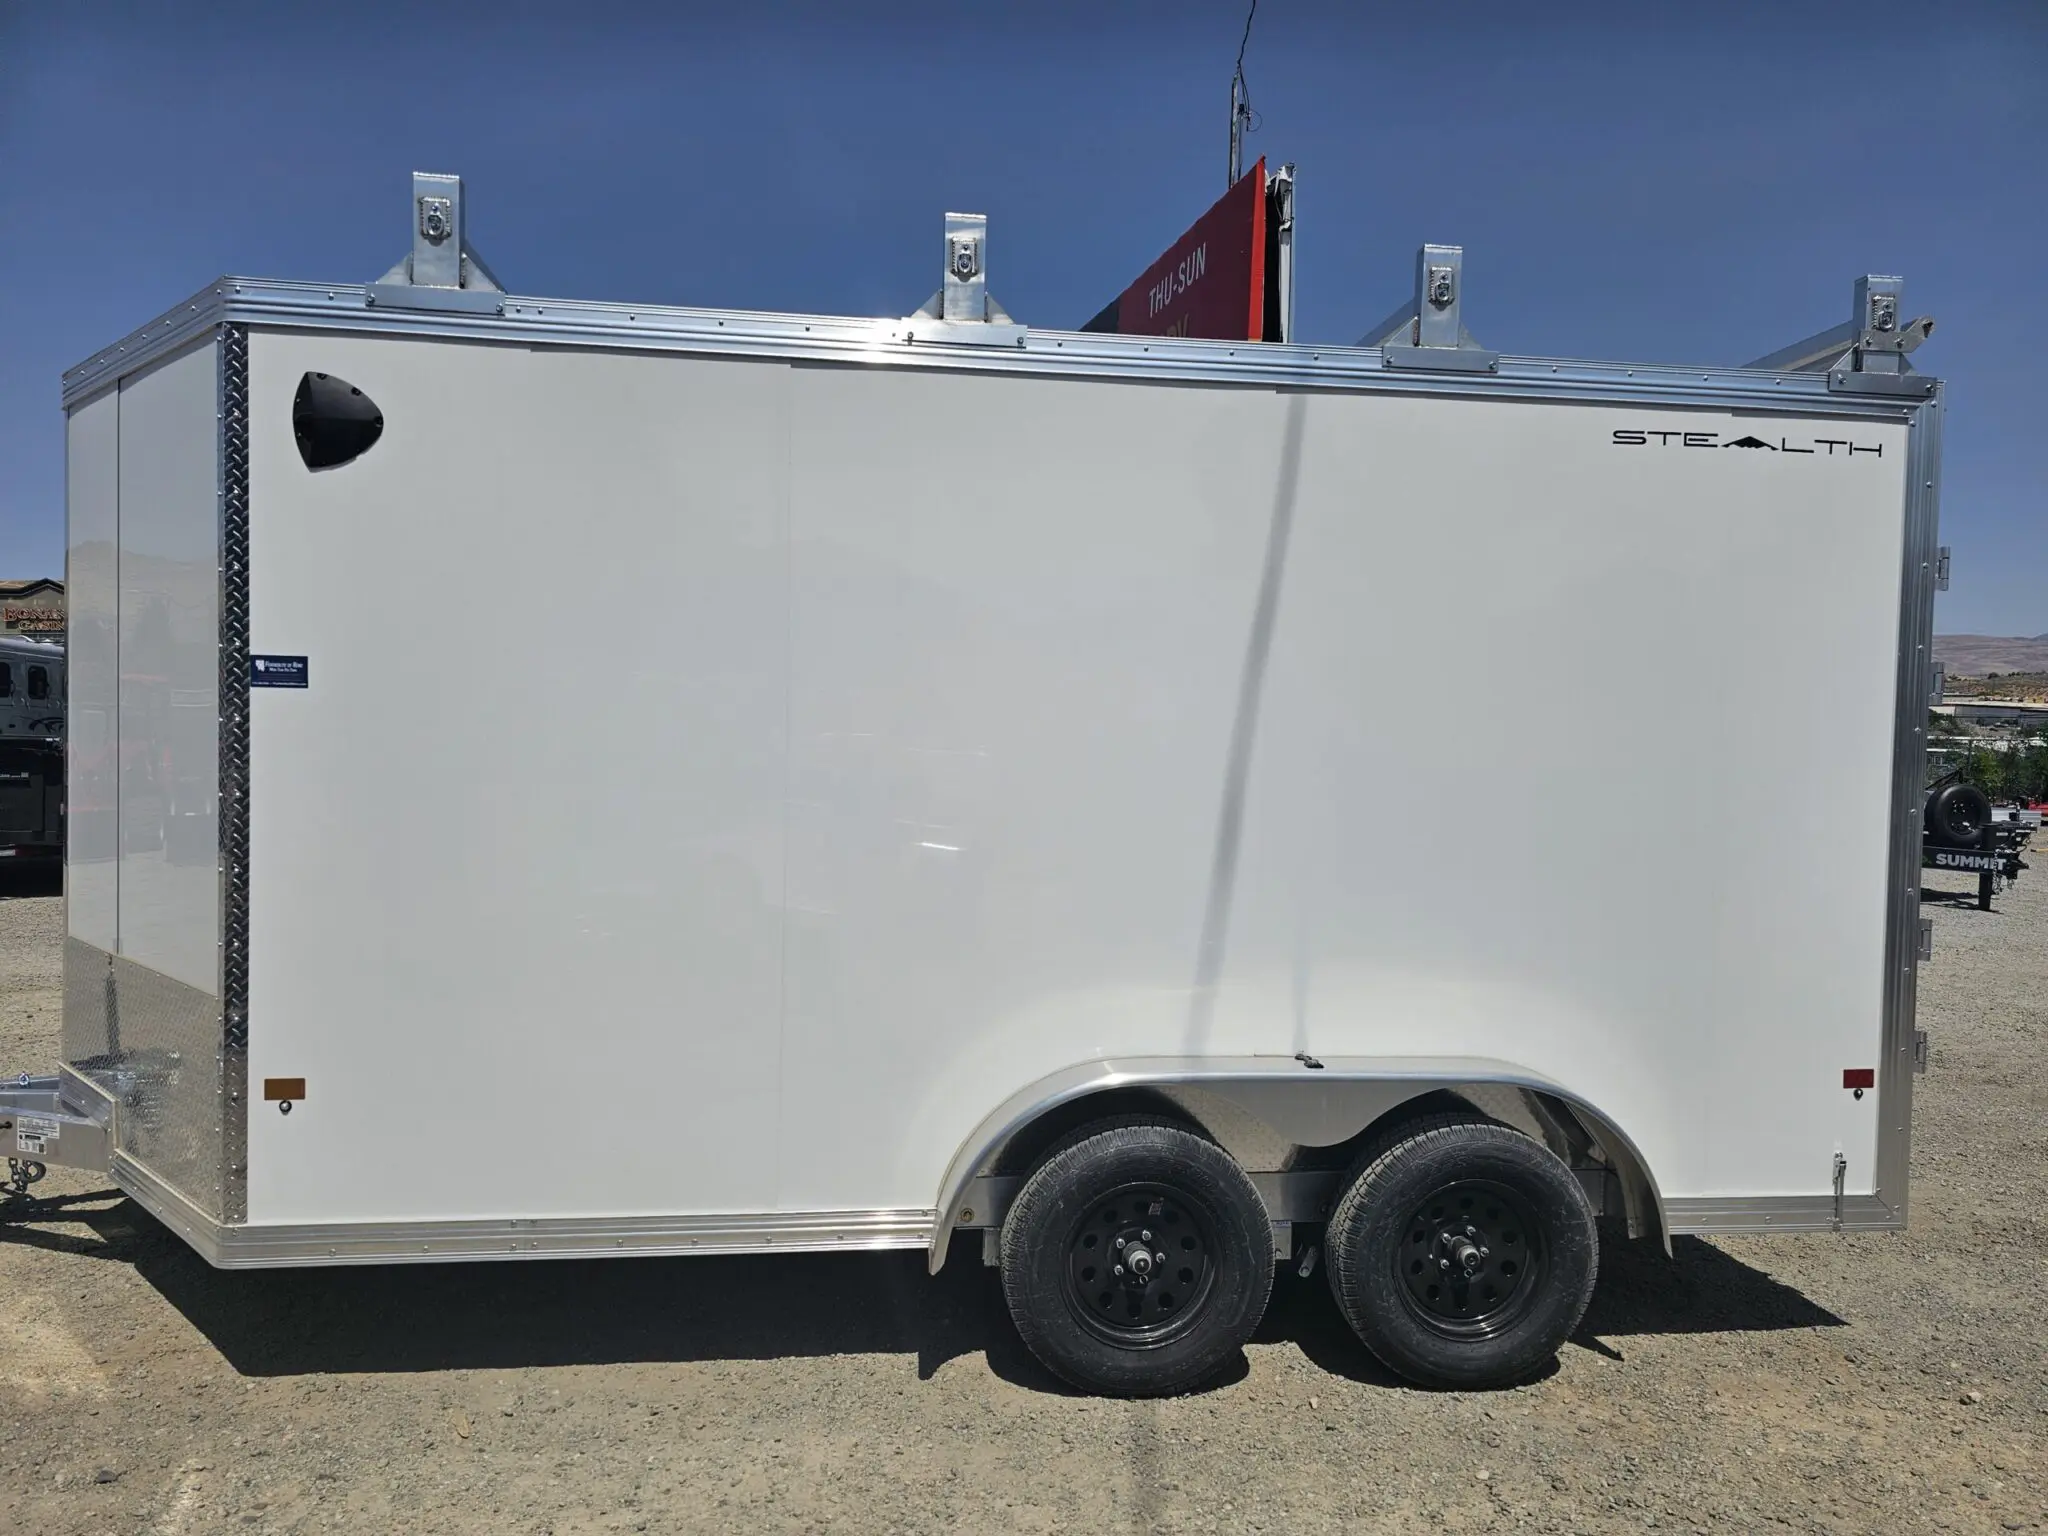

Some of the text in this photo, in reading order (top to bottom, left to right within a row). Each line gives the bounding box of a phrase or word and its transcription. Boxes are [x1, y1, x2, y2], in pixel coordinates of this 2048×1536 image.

[1148, 242, 1207, 318] THU-SUN
[1612, 429, 1883, 458] STEALTH
[1936, 853, 2007, 871] SUMMIT
